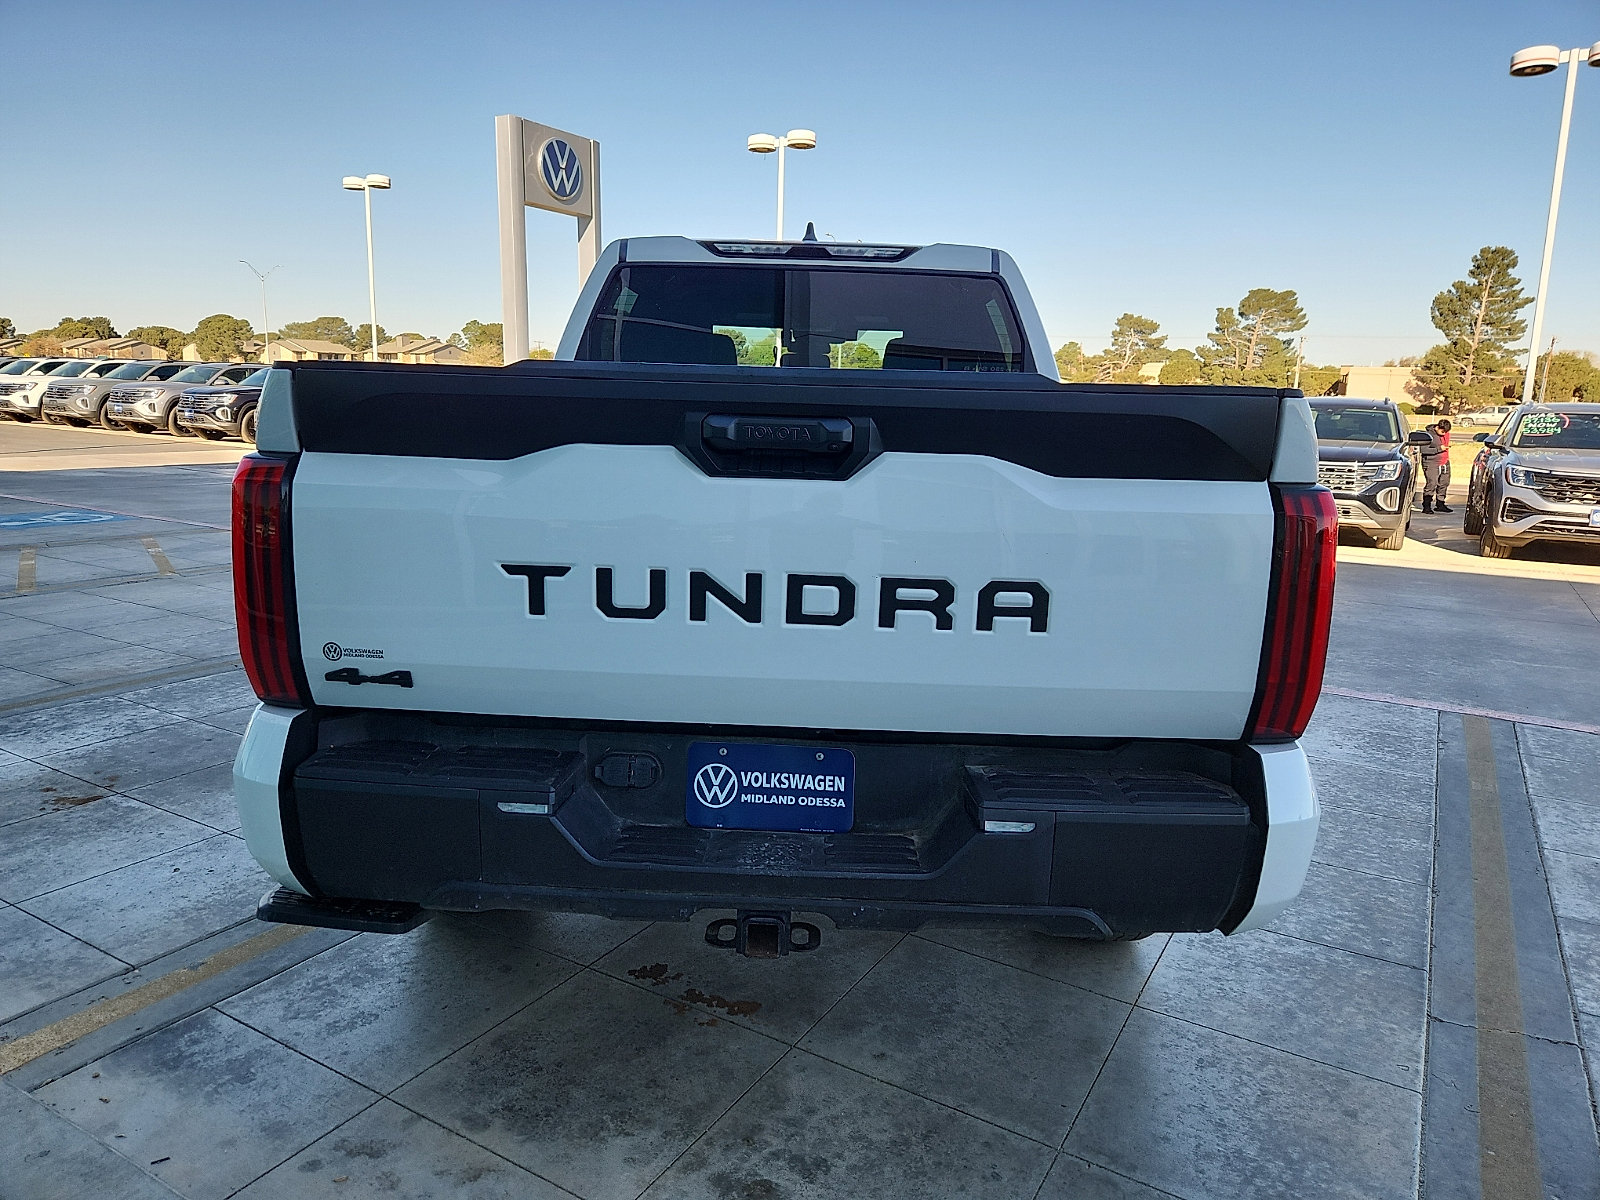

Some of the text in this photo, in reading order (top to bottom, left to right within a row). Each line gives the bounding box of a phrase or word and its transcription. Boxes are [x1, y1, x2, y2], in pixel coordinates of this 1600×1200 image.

[743, 425, 812, 441] TOYOTA
[499, 563, 1050, 634] TUNDRA
[740, 771, 846, 792] VOLKSWAGEN
[741, 793, 846, 808] MIDLAND ODESSA
